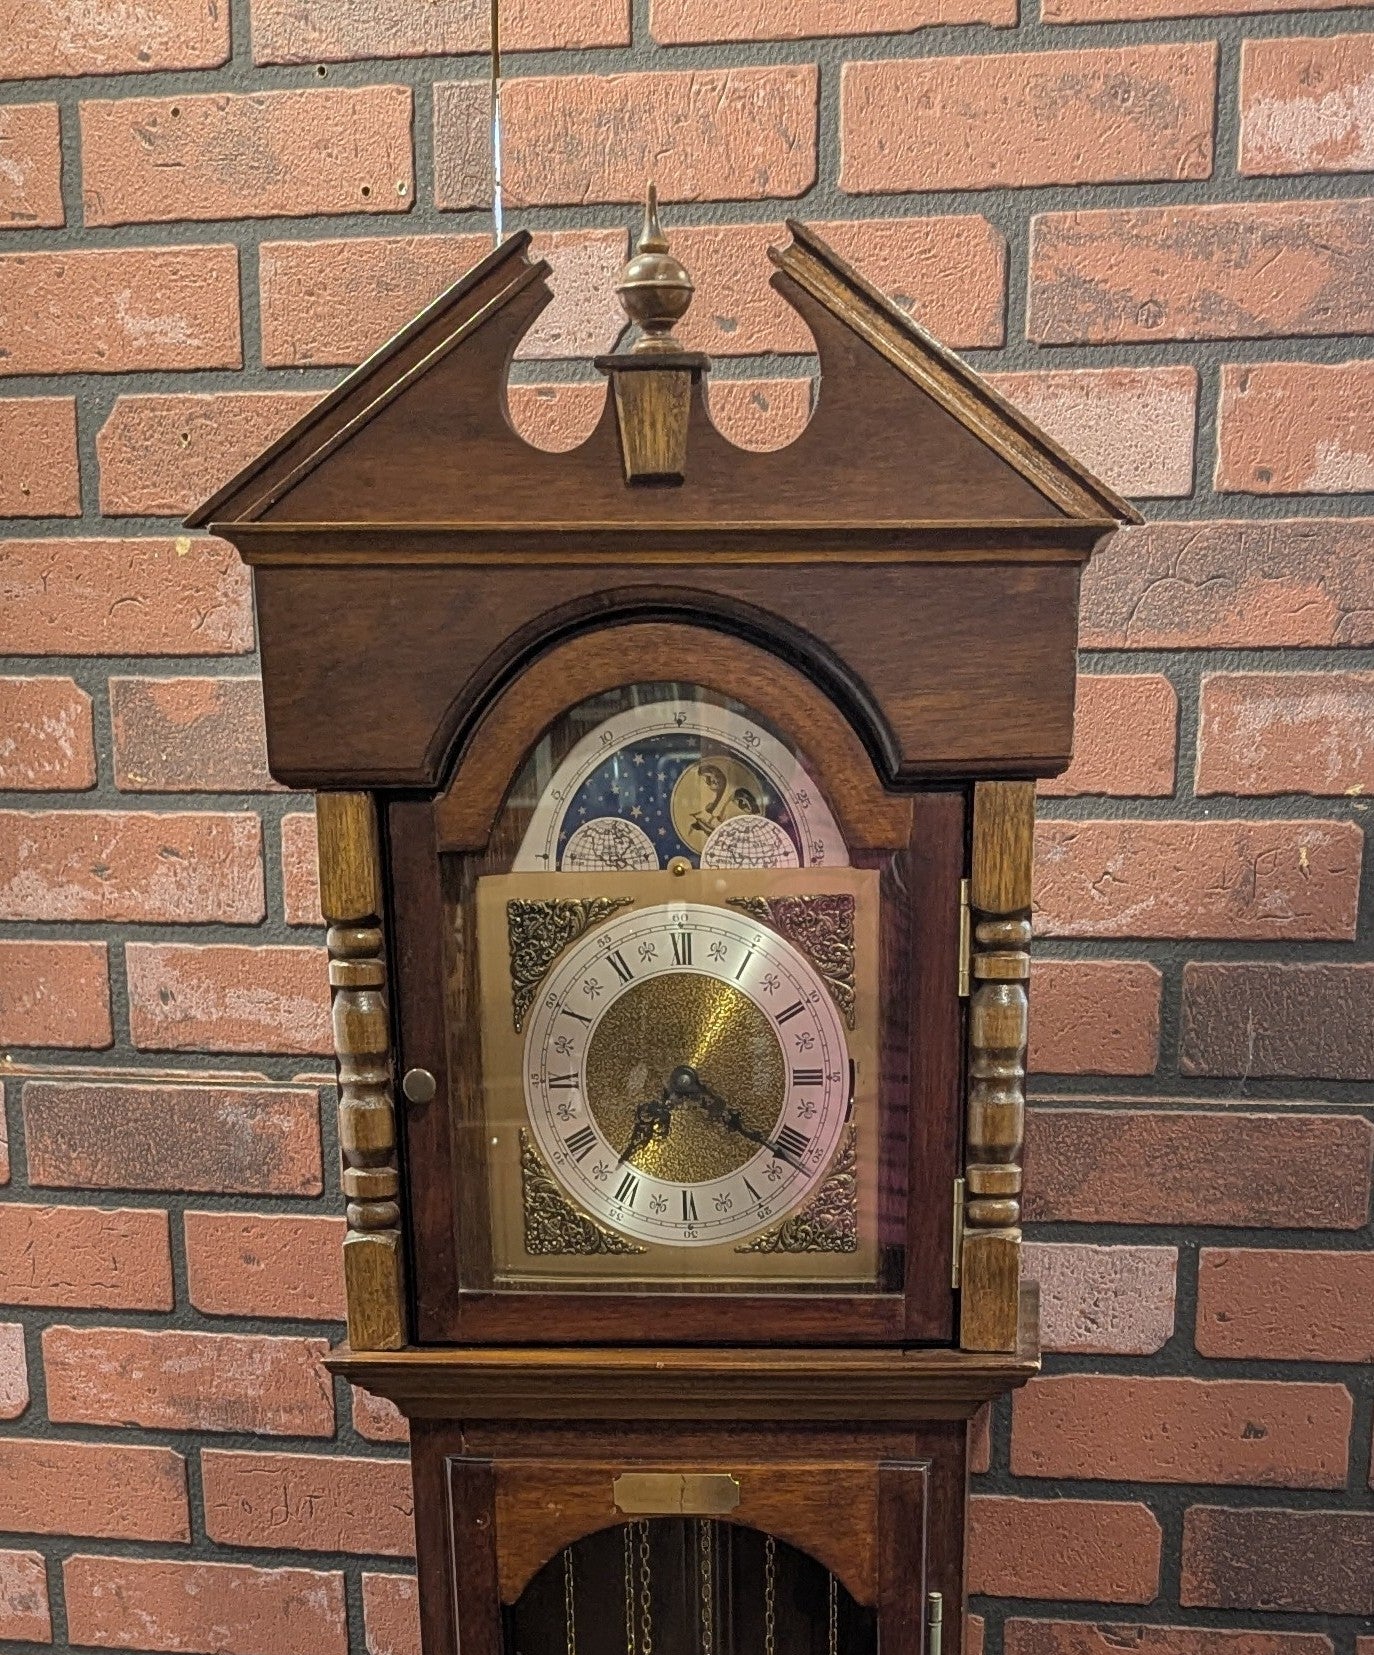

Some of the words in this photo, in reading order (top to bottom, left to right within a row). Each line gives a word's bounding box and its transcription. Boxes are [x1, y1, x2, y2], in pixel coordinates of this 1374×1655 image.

[673, 711, 688, 722] 15
[599, 730, 614, 745] 10
[742, 730, 761, 748] 20
[551, 789, 561, 800] 5
[796, 789, 812, 809] 25
[672, 913, 689, 922] 60
[596, 934, 612, 948] 55
[752, 934, 762, 943] 5
[670, 932, 692, 966] XII
[605, 950, 635, 987] XI
[735, 949, 755, 981] I
[545, 992, 558, 1009] 50
[808, 990, 821, 1004] 10
[560, 1003, 593, 1030] X
[774, 1000, 806, 1026] II
[548, 1072, 579, 1089] IX
[792, 1069, 824, 1087] III
[832, 1071, 841, 1083] 15
[564, 1124, 599, 1163] VIII
[614, 1172, 640, 1208] VII
[742, 1175, 763, 1204] V
[681, 1190, 699, 1222] VI
